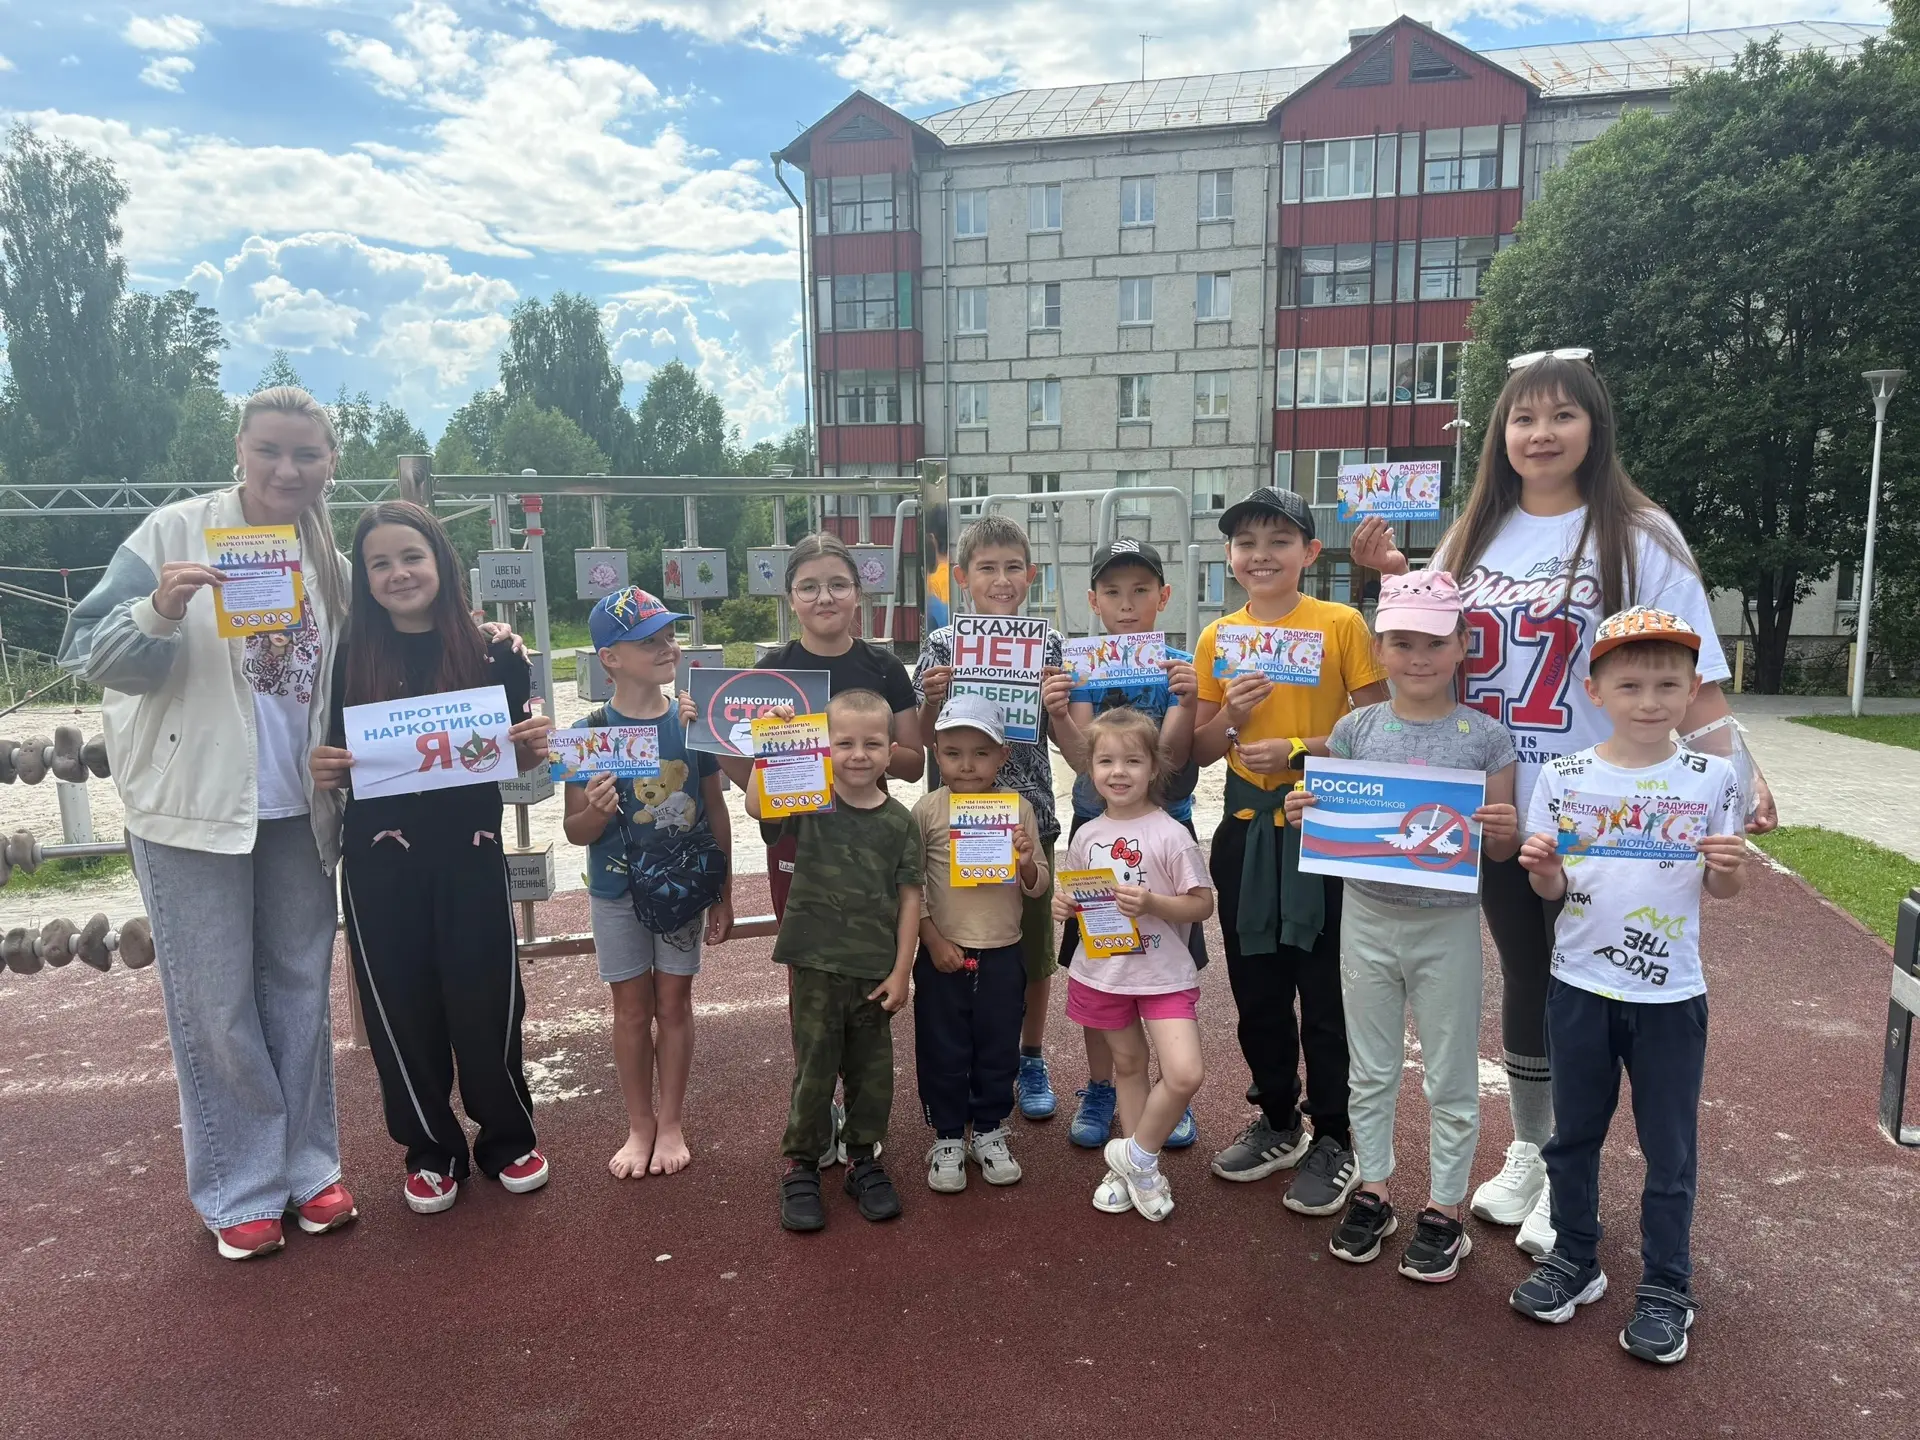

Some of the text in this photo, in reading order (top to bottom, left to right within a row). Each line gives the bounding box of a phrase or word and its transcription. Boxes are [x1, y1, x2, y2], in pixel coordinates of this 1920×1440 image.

[1400, 463, 1439, 474] РАДУЙСЯ!
[495, 565, 520, 576] ЦВЕТЫ
[490, 578, 527, 589] САДОВЫЕ
[1460, 566, 1602, 624] Chicago
[956, 619, 1044, 638] СКАЖИ
[1127, 633, 1164, 642] РАДУЙСЯ!
[1284, 630, 1322, 642] РАДУЙСЯ!
[955, 636, 1042, 668] НЕТ
[954, 668, 1039, 680] НАРКОТИКАМ
[1455, 606, 1586, 734] 27
[953, 684, 1038, 705] ВЫБЕРИ
[724, 696, 794, 706] НАРКОТИКИ
[389, 702, 472, 722] ПРОТИВ
[364, 712, 506, 741] НАРКОТИКОВ
[618, 727, 656, 736] РАДУЙСЯ!
[1520, 736, 1538, 749] IS
[416, 730, 453, 772] Я
[1553, 758, 1592, 769] RULES
[1558, 766, 1585, 777] HERE
[1311, 778, 1384, 797] РОССИЯ
[1636, 779, 1669, 792] FUN
[1346, 798, 1406, 809] НАРКОТИКОВ
[1562, 800, 1609, 817] МЕЧТАЙ!
[1657, 802, 1708, 814] РАДУЙСЯ!
[1600, 849, 1642, 857] ЗДОРОВЫЙ
[1642, 851, 1666, 859] ОБРАЗ
[1659, 860, 1674, 870] ON
[508, 866, 540, 877] АСТЕНИЯ
[1624, 906, 1688, 940] DAY
[1624, 926, 1670, 958] THE
[1593, 946, 1670, 986] ENJOY
